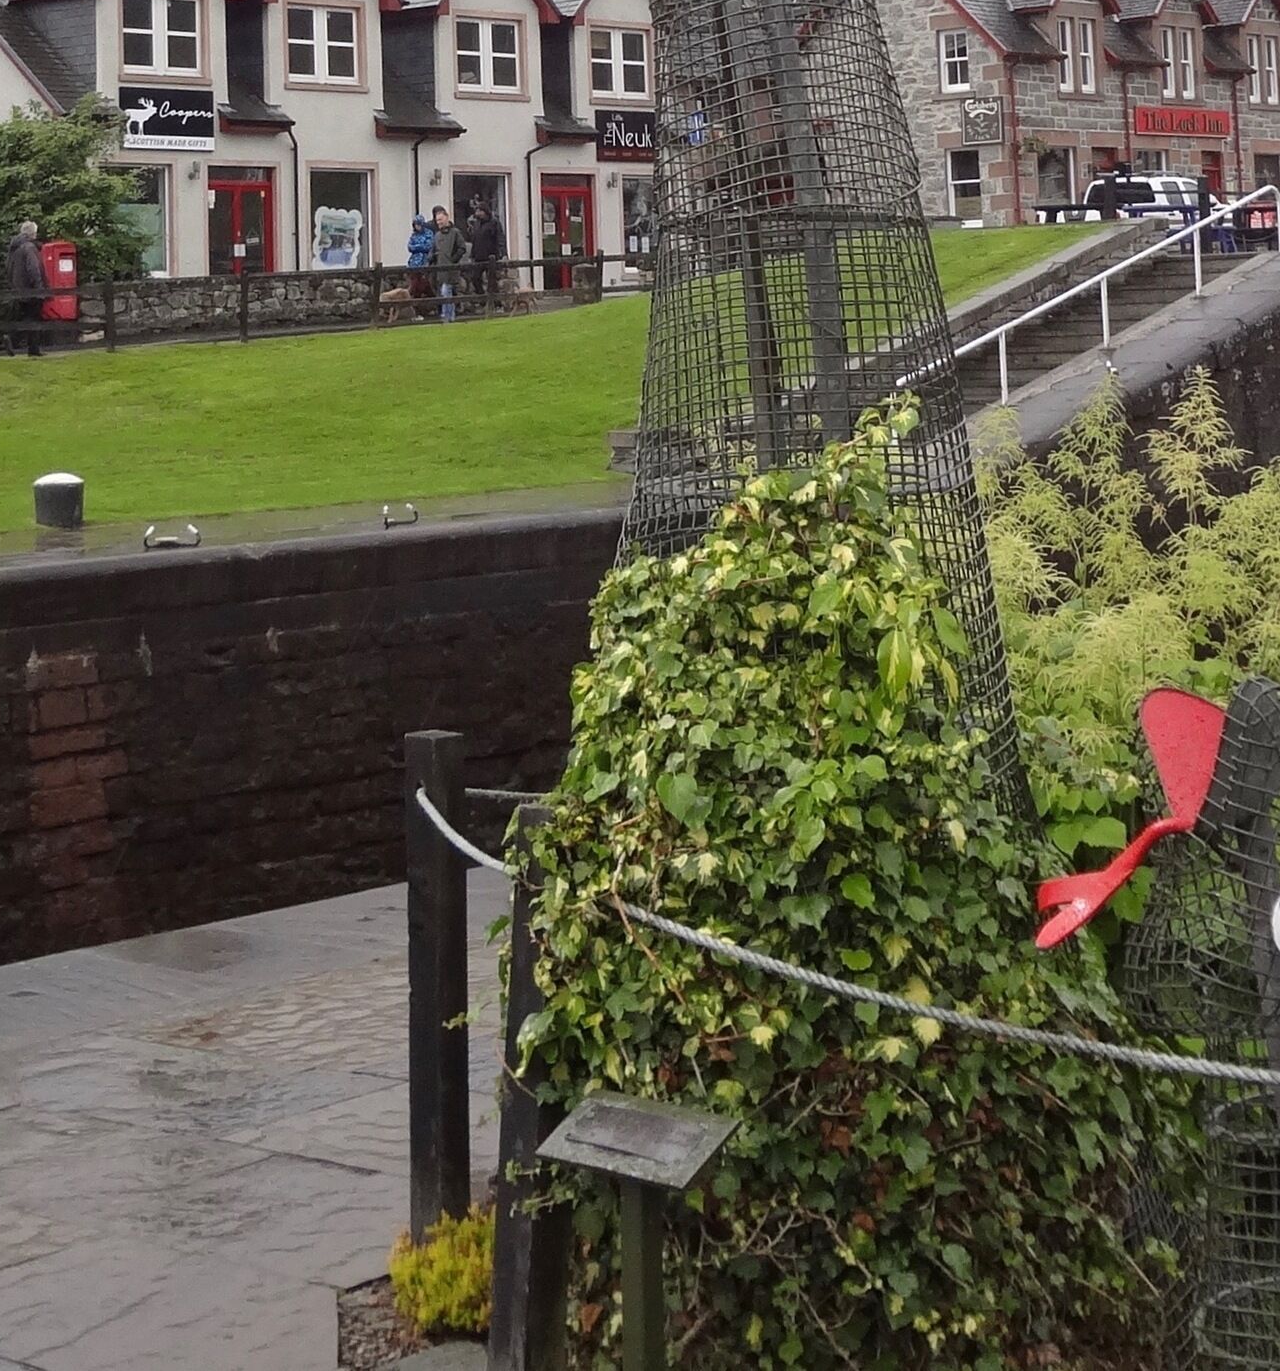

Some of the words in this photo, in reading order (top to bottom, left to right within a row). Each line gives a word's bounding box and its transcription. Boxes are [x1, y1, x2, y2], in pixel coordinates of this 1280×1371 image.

[159, 101, 214, 125] Coopers
[1142, 111, 1167, 131] The
[1169, 112, 1199, 132] Lock
[1202, 113, 1224, 133] Inn
[603, 122, 613, 146] The
[612, 122, 653, 148] Neuk
